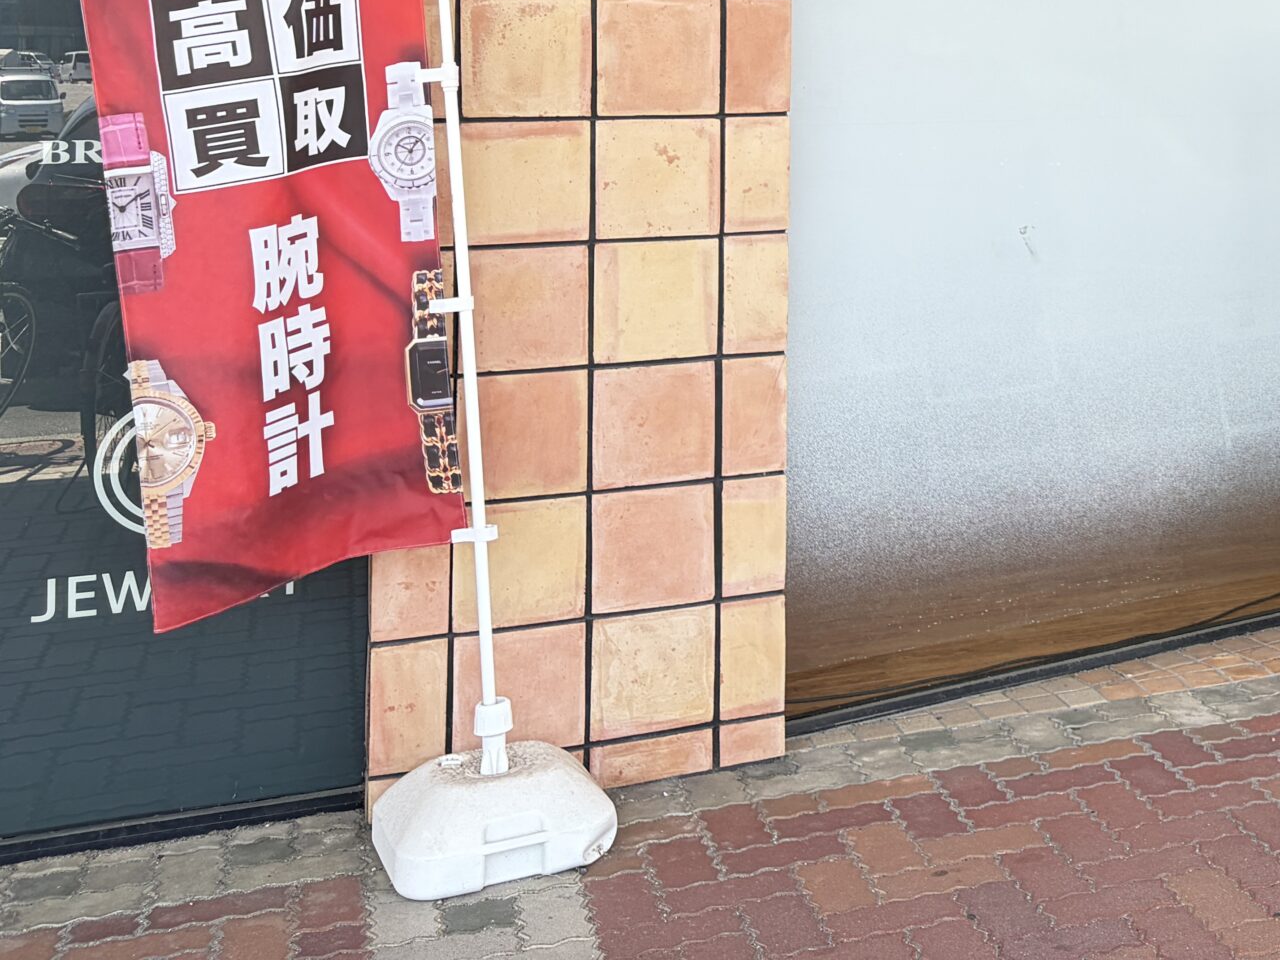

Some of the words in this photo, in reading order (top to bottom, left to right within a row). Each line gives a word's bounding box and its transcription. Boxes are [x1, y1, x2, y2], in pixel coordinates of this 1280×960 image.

[186, 86, 352, 177] 買取
[248, 214, 335, 497] 腕時計
